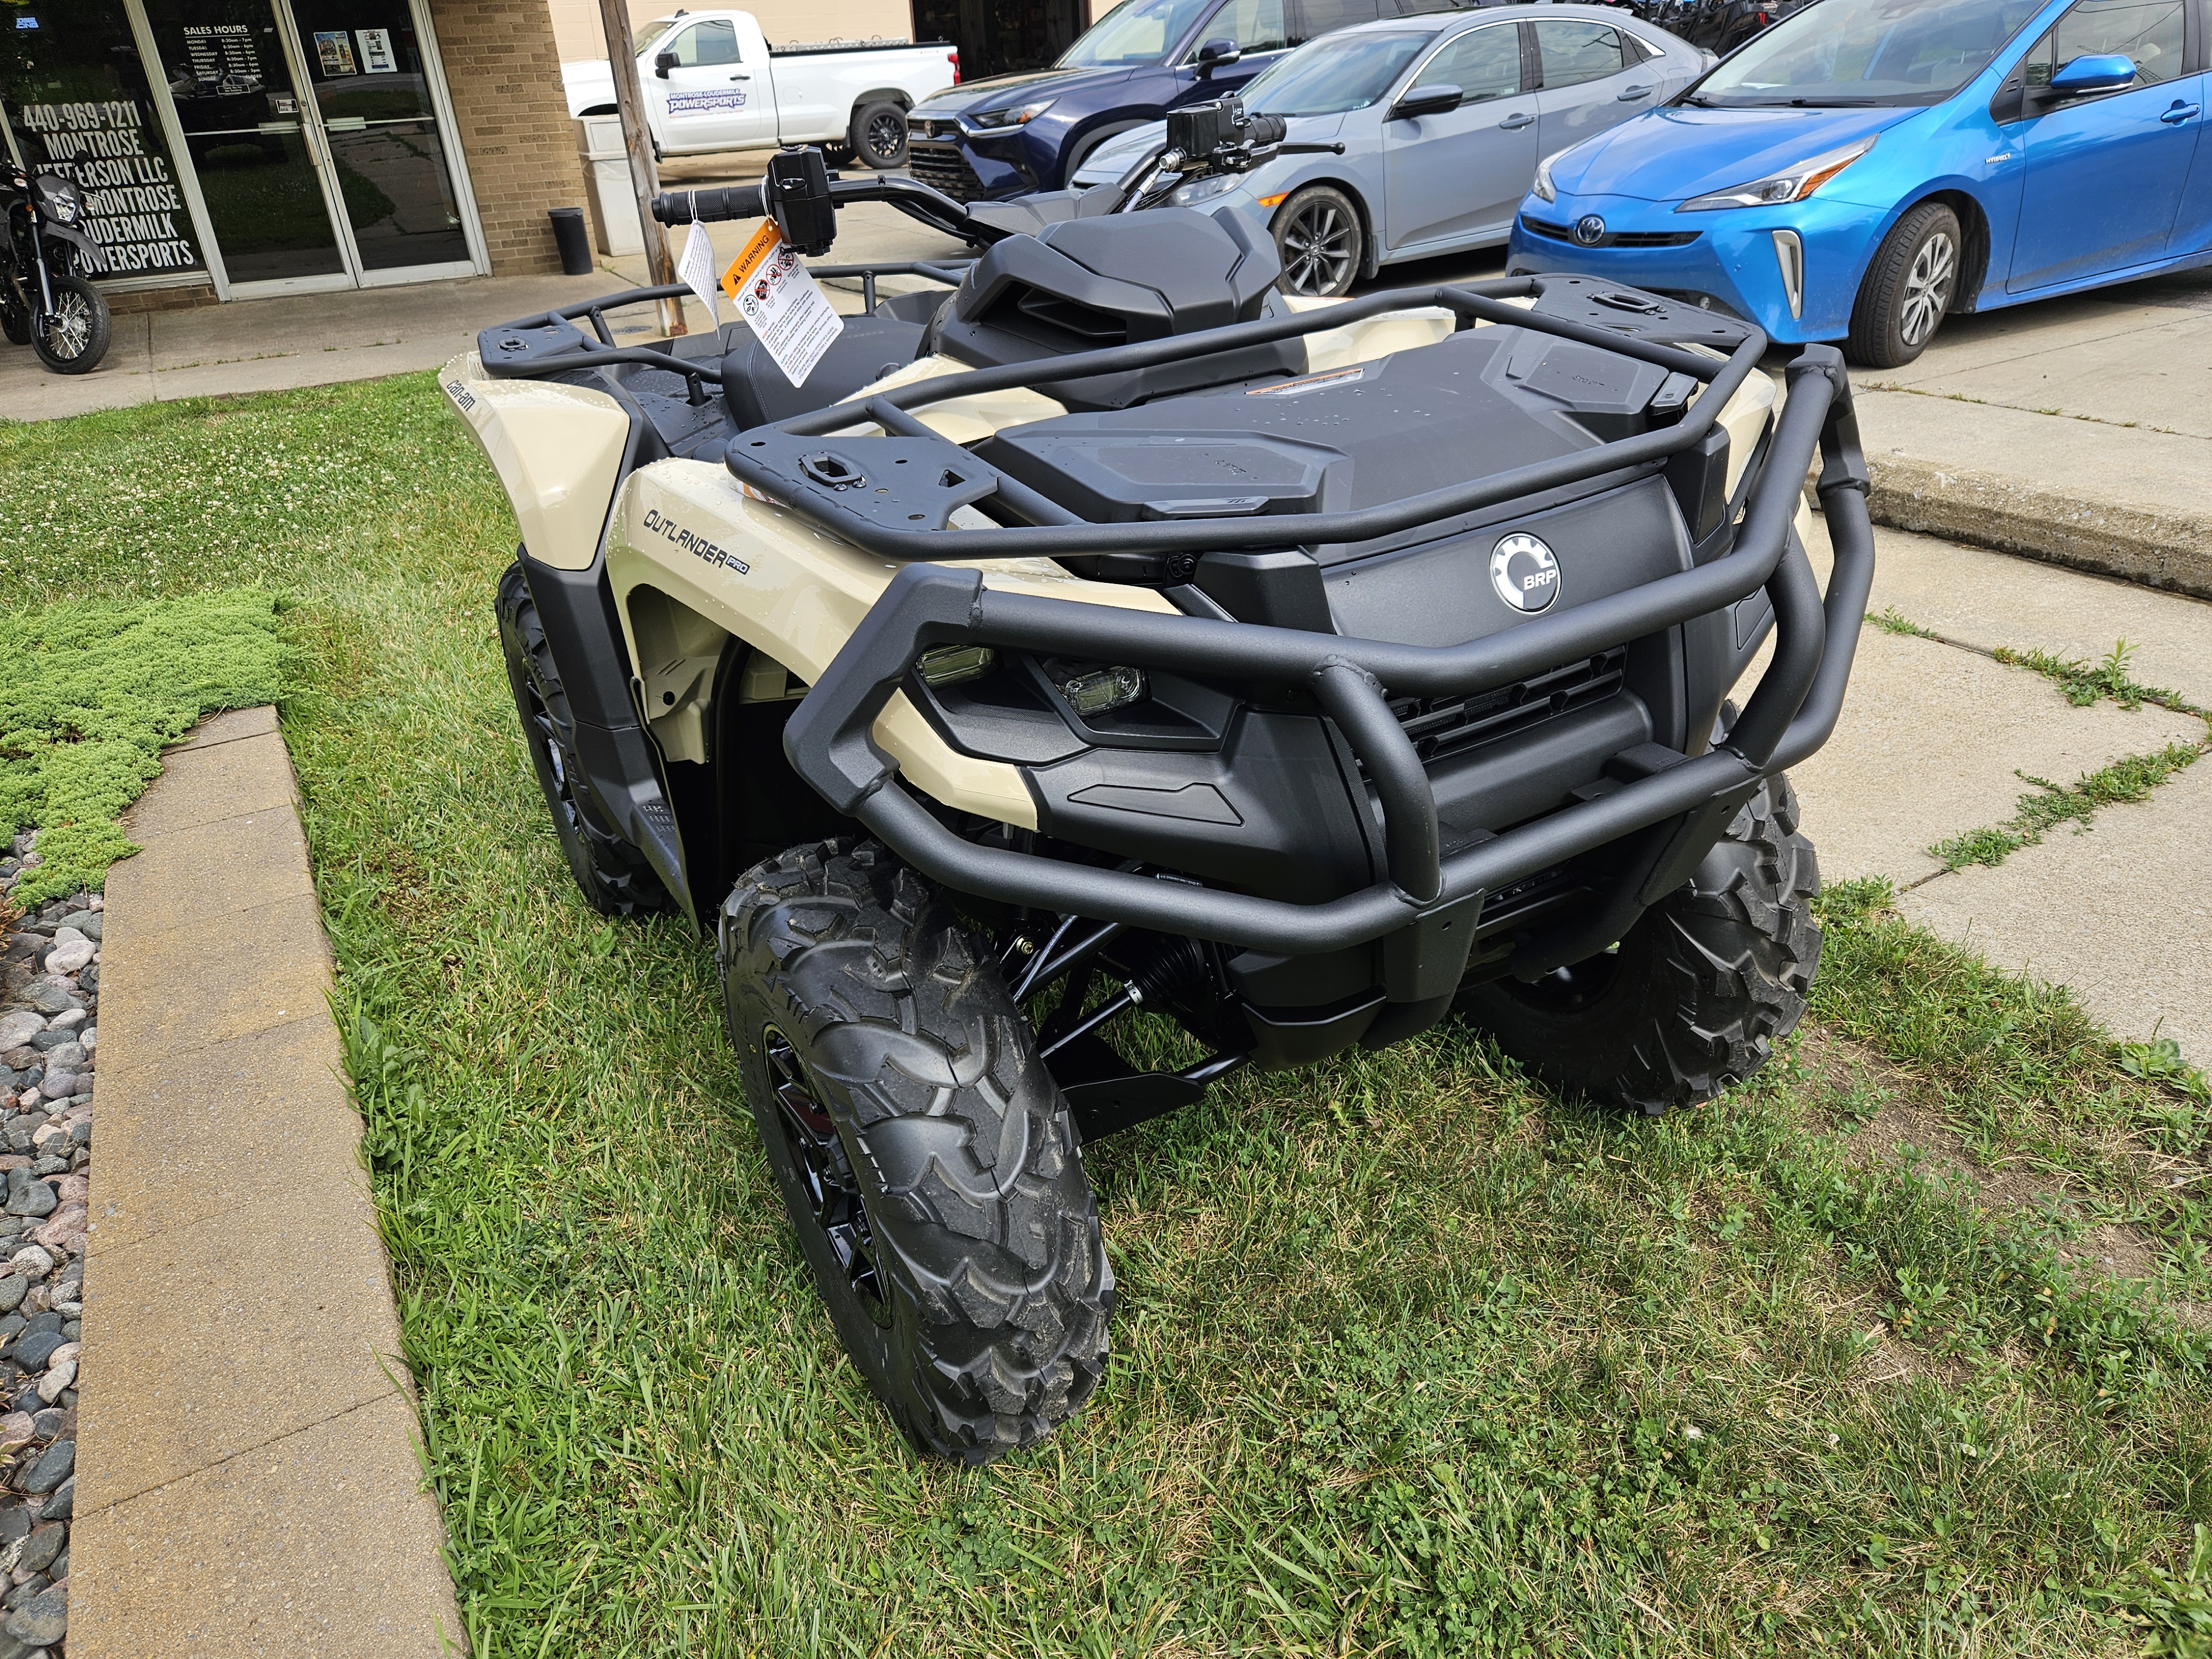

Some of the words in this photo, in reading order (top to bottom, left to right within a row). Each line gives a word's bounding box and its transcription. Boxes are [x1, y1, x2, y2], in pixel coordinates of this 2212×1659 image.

[184, 27, 212, 35] SALES
[213, 25, 248, 34] HOURS
[23, 100, 142, 132] 440-969-1211
[667, 95, 746, 113] POWERSPORTS
[43, 129, 144, 160] MONTROSE
[1986, 154, 2007, 164] HYBRID
[134, 156, 168, 184] LLC
[85, 185, 181, 217] MONTROSE
[73, 240, 194, 274] POWERSPORTS
[739, 235, 769, 273] WARNING
[447, 379, 476, 411] can-am
[644, 509, 728, 568] OUTLANDER
[726, 556, 749, 574] PRO
[1524, 568, 1557, 591] BRP
